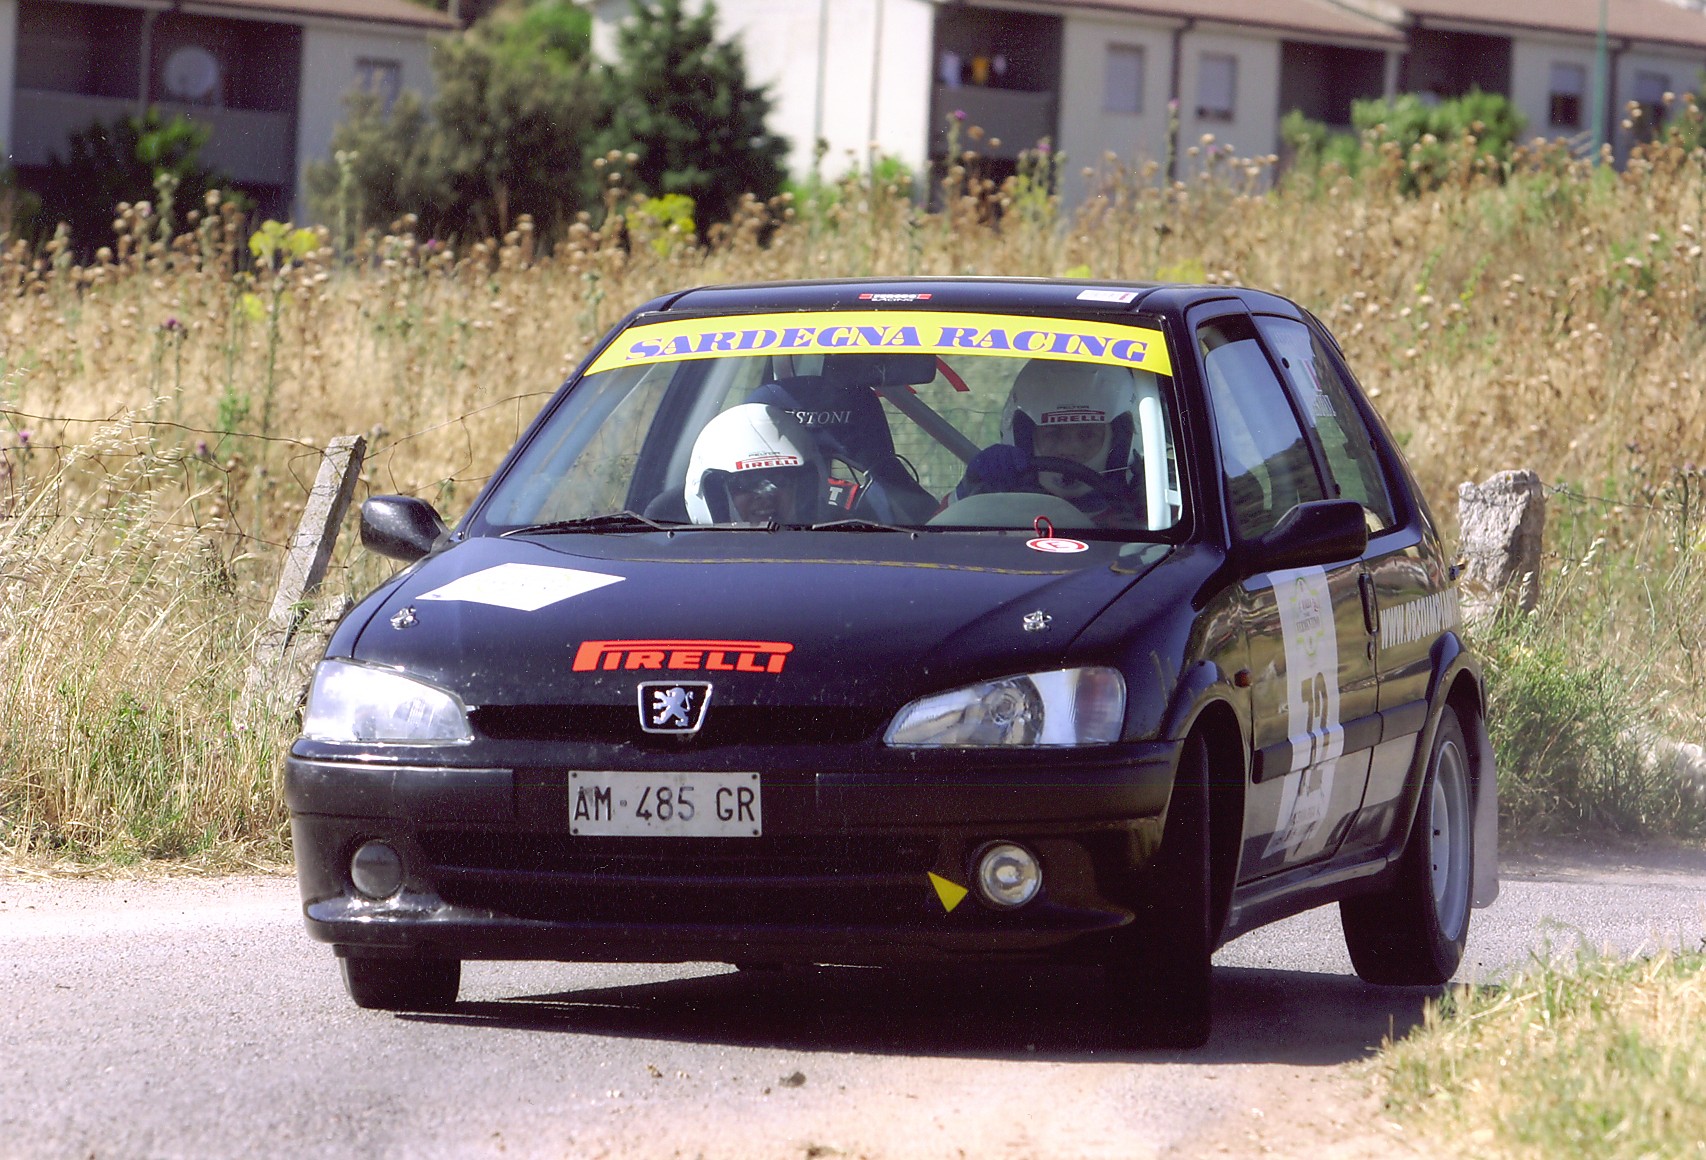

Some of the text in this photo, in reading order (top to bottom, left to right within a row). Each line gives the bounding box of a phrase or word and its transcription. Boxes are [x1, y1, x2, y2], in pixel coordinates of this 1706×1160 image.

[626, 325, 1149, 362] SARDEGNA RACING
[1041, 409, 1105, 423] PIRELLI
[735, 455, 799, 470] PIRELLI
[572, 639, 795, 674] PIRELLI
[573, 785, 756, 822] AM 485 GR
